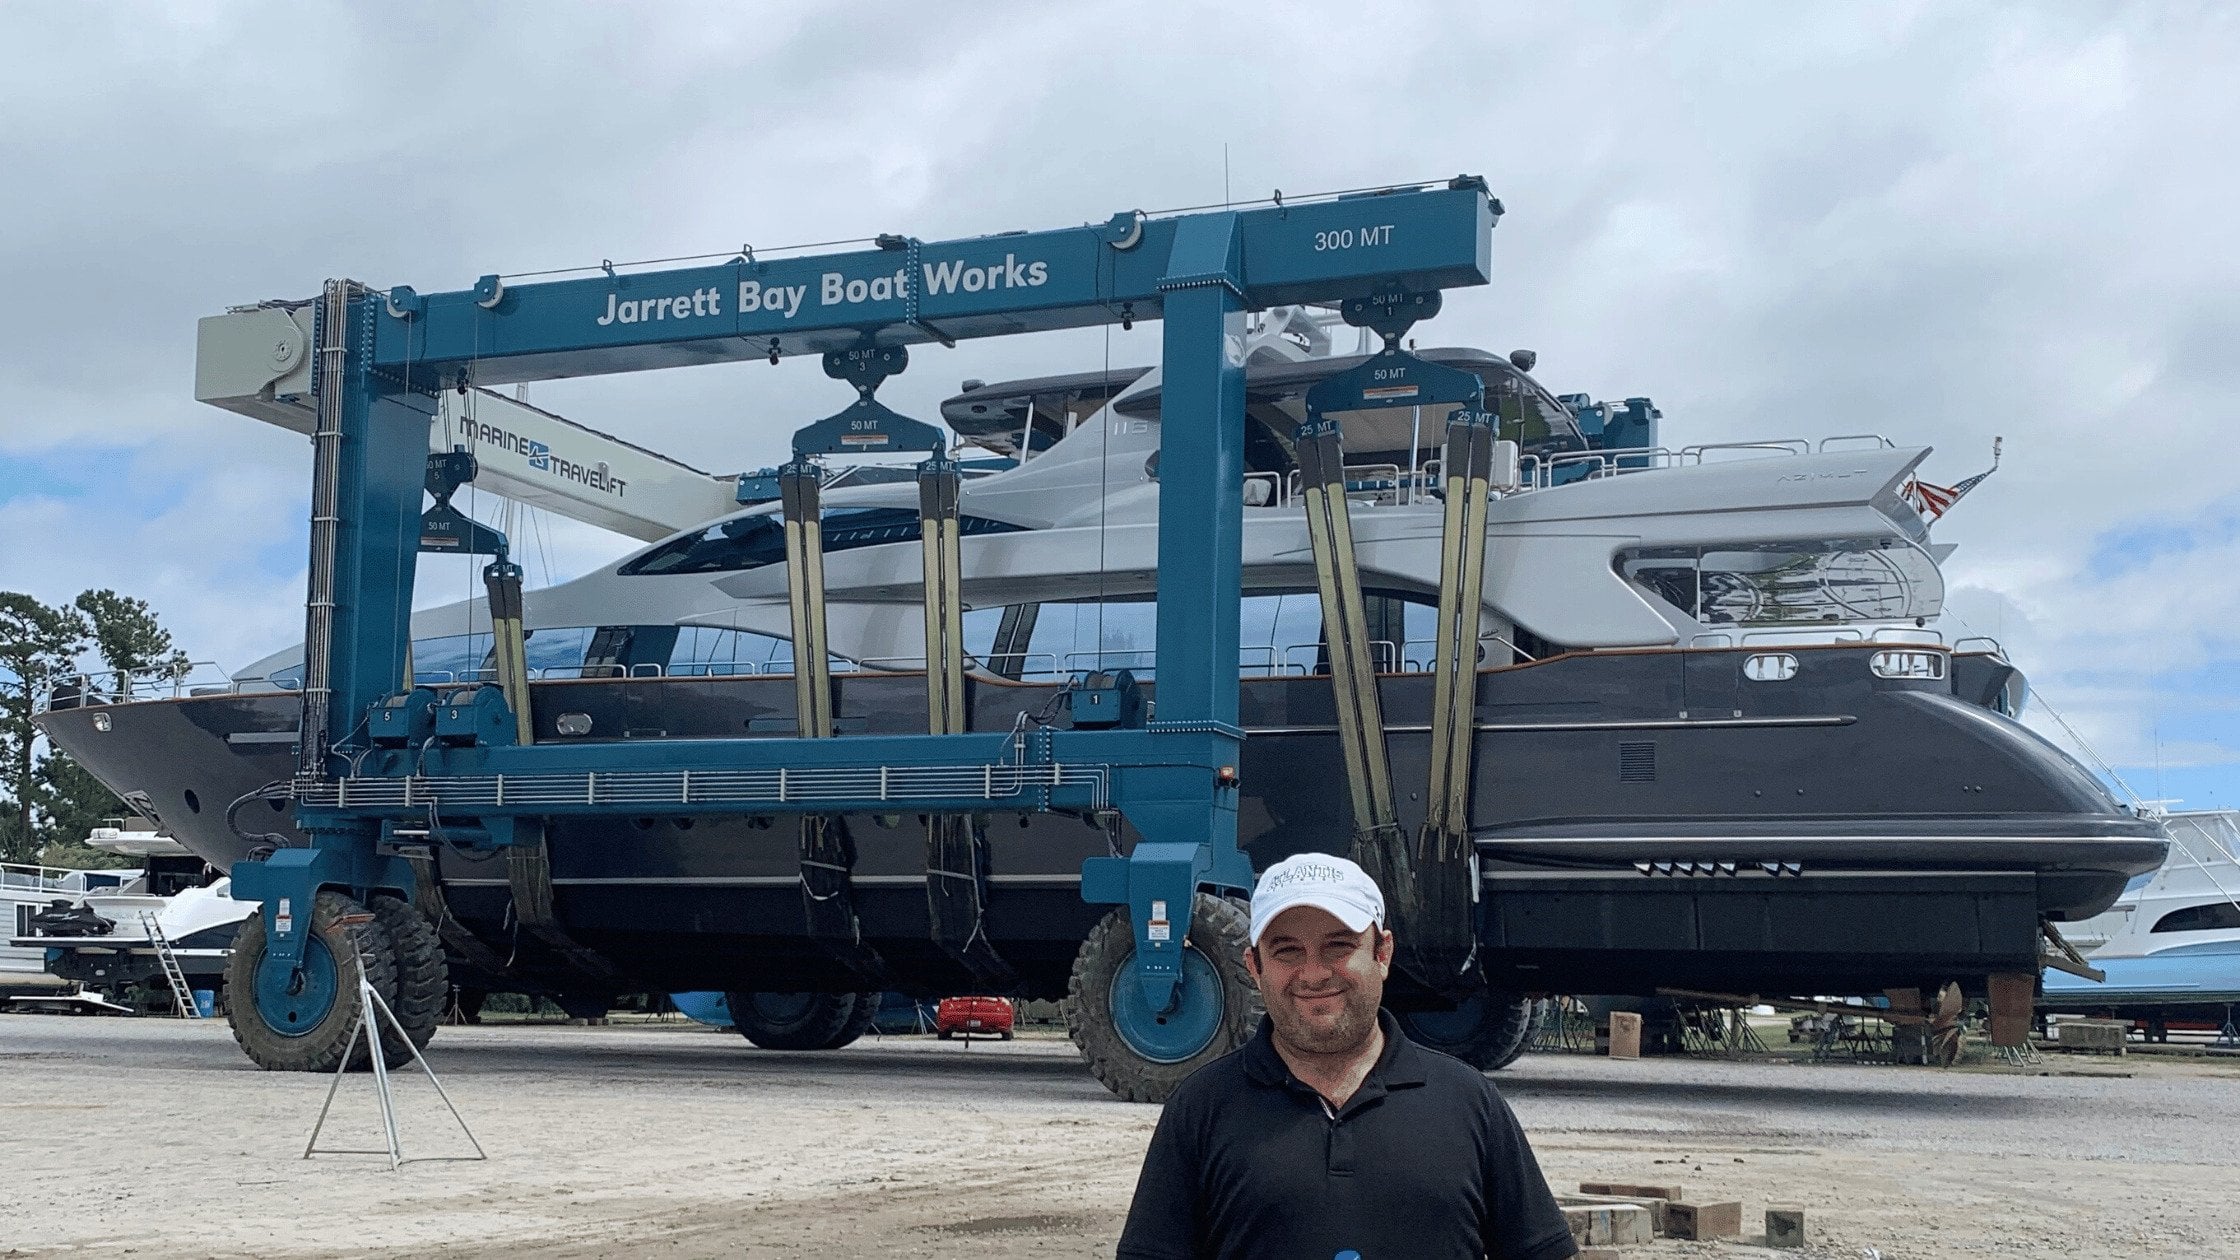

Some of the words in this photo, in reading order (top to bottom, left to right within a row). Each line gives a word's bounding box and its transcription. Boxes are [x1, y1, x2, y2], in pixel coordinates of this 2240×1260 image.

[1314, 229, 1353, 251] 300
[1360, 225, 1395, 247] MT
[597, 287, 721, 326] Jarrett
[739, 280, 806, 319] Bay
[821, 271, 908, 306] Boat
[924, 254, 1048, 296] Works
[1387, 306, 1393, 316] 1
[849, 351, 860, 361] 50
[862, 349, 875, 359] MT
[859, 361, 866, 371] 3
[1374, 369, 1388, 380] 50
[1389, 367, 1406, 379] MT
[1457, 411, 1471, 422] 25
[1475, 412, 1493, 424] MT
[851, 420, 862, 431] 50
[864, 420, 878, 430] MT
[1301, 424, 1313, 435] 25
[1317, 421, 1332, 433] MT
[459, 416, 529, 456] MARINE
[435, 459, 447, 469] MT
[800, 464, 813, 474] MT
[925, 462, 937, 471] 25
[939, 461, 954, 472] MT
[428, 521, 438, 531] 50
[439, 522, 451, 531] MT
[1092, 694, 1098, 705] 1
[384, 711, 391, 722] 5
[451, 709, 458, 720] 3
